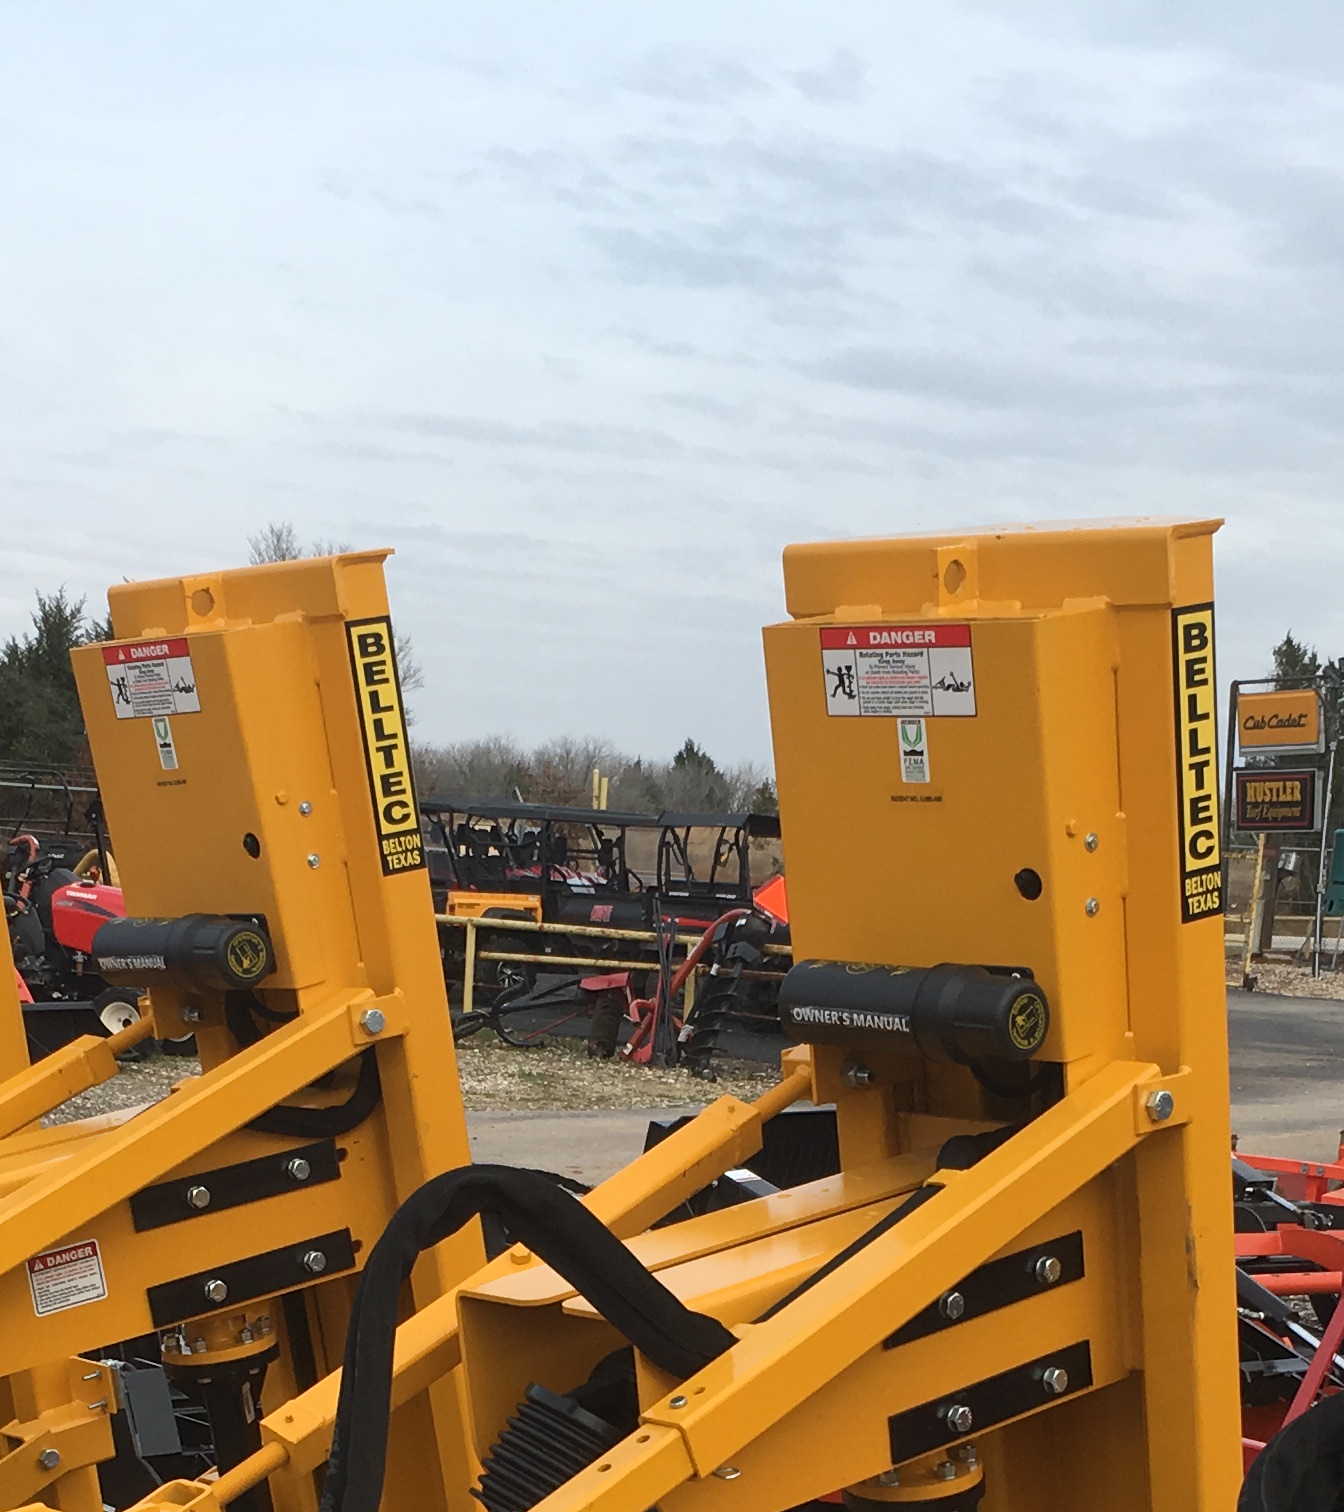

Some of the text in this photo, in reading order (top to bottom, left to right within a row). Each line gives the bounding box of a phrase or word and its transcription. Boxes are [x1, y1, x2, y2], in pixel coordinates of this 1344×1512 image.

[869, 631, 936, 644] DANGER
[130, 644, 169, 659] DANGER
[357, 632, 412, 826] BELLTEC
[1243, 714, 1308, 730] Cub Cadet
[1182, 622, 1215, 860] BELLTEC
[1246, 781, 1301, 802] HUSTLER
[1246, 805, 1301, 821] Turf Equipment
[382, 834, 420, 854] BELTON
[387, 850, 420, 869] TEXAS
[1185, 871, 1221, 896] BELTON
[1188, 892, 1219, 916] TEXAS
[98, 958, 133, 970] OWNER'S
[793, 1007, 910, 1032] OWNER'S MANUAL
[47, 1247, 92, 1267] DANGER
